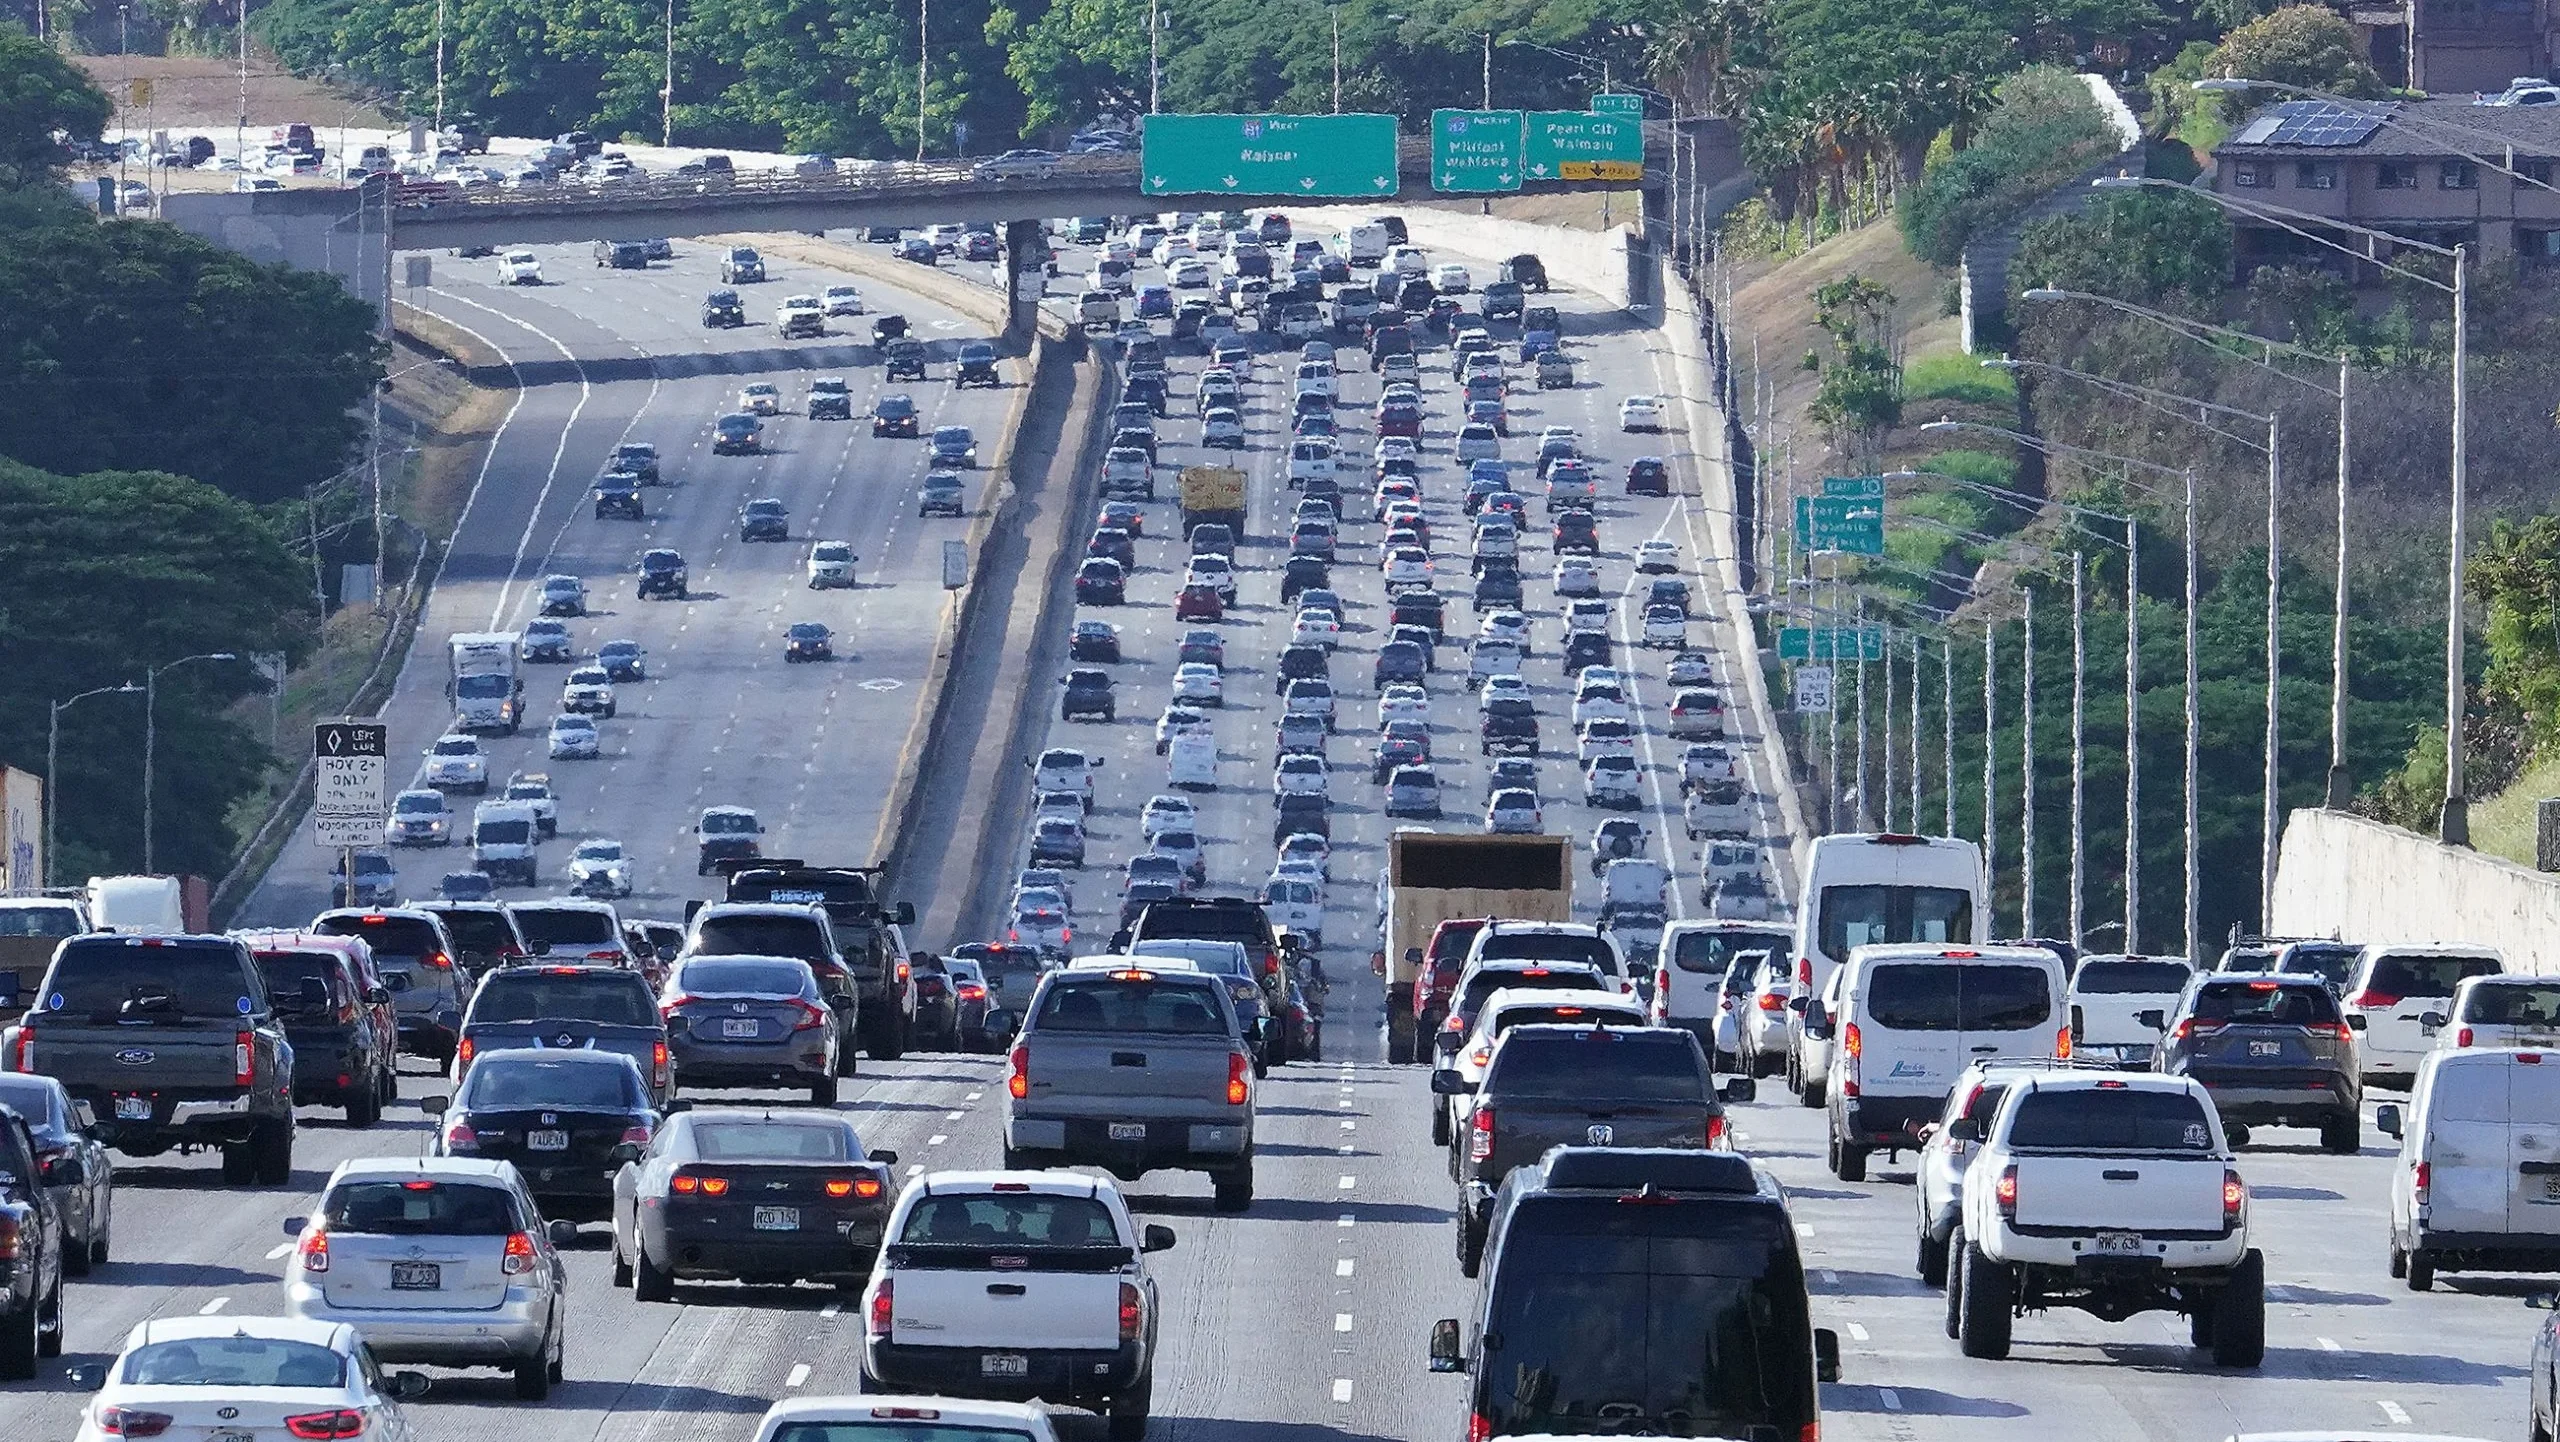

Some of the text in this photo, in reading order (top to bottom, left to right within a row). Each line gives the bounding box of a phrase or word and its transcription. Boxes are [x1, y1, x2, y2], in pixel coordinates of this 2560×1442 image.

[1622, 98, 1639, 110] 10
[1546, 123, 1618, 136] Pearl City
[326, 760, 376, 771] HOV 2+
[333, 774, 368, 787] ONLY
